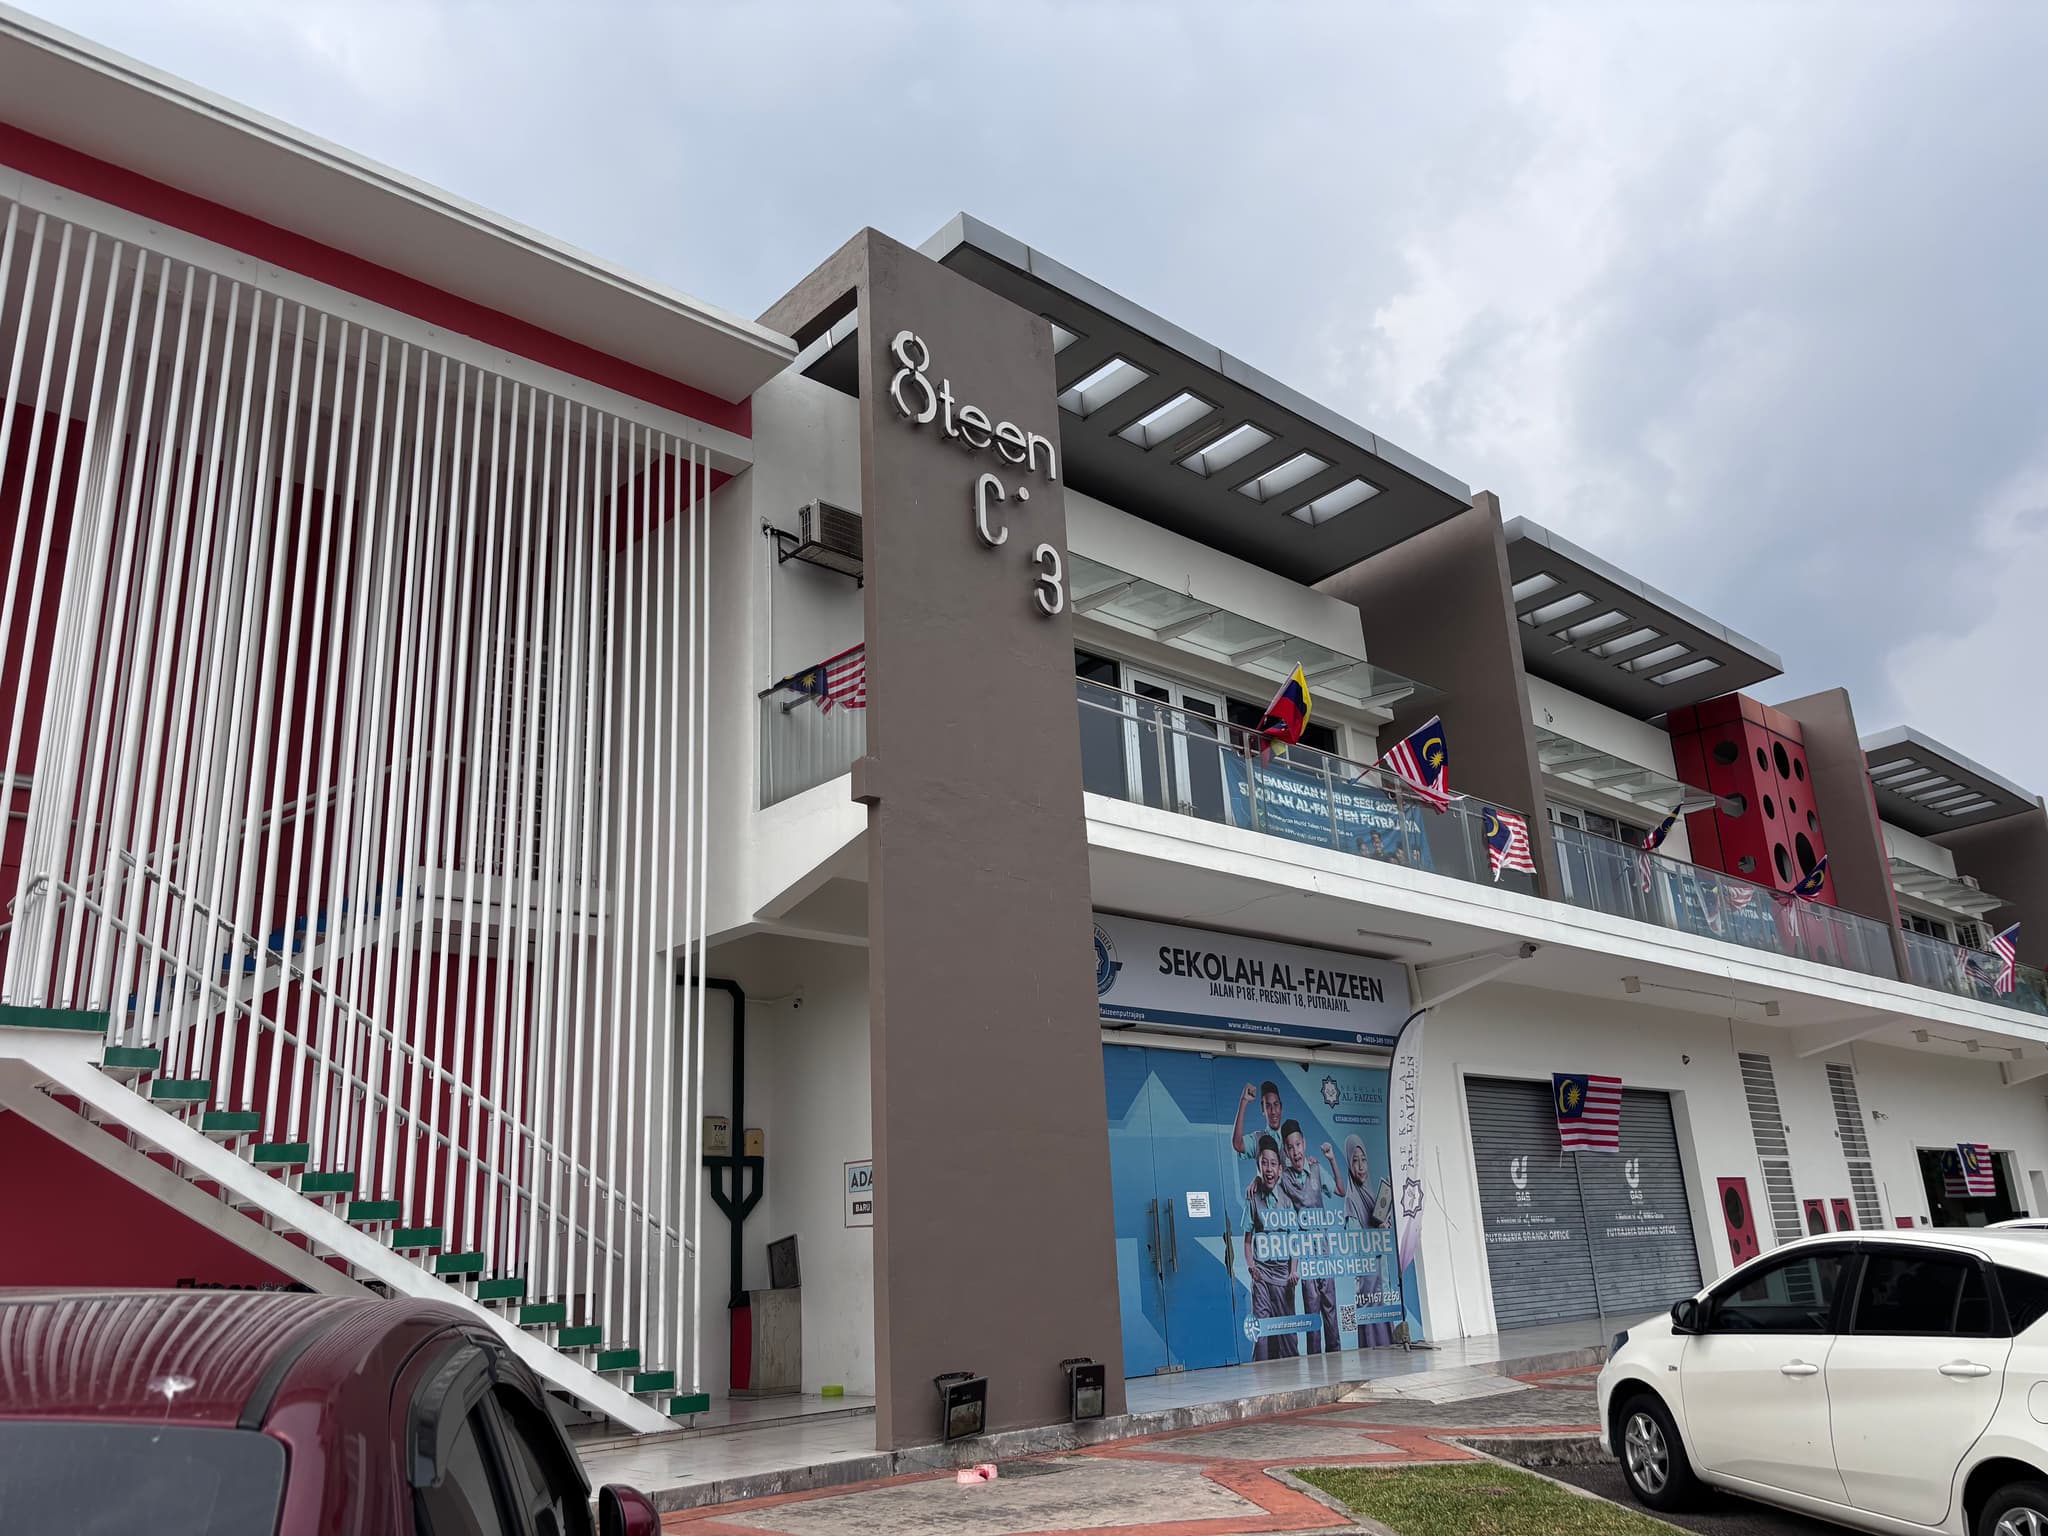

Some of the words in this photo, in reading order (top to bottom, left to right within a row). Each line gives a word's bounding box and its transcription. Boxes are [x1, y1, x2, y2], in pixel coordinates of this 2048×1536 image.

[891, 330, 1057, 481] 8teen
[1319, 789, 1352, 806] MRID
[1360, 814, 1420, 833] PUTRAJYA
[1159, 946, 1265, 987] SEKOLAH
[1270, 963, 1384, 1003] AL-FAIZEEN
[1209, 982, 1234, 998] JALAN
[1236, 985, 1258, 1003] P18F,
[1259, 989, 1291, 1006] PRESINT
[1294, 994, 1306, 1009] 18,
[1261, 1211, 1297, 1228] YOUR
[1300, 1208, 1345, 1226] CHILD'S
[1549, 1230, 1570, 1241] OFFICE
[1659, 1224, 1676, 1235] OFFICE
[1257, 1233, 1325, 1258] BRIGHT
[1328, 1231, 1393, 1256] FUTURE
[1301, 1259, 1344, 1277] BEGINS
[1347, 1257, 1377, 1274] HERE
